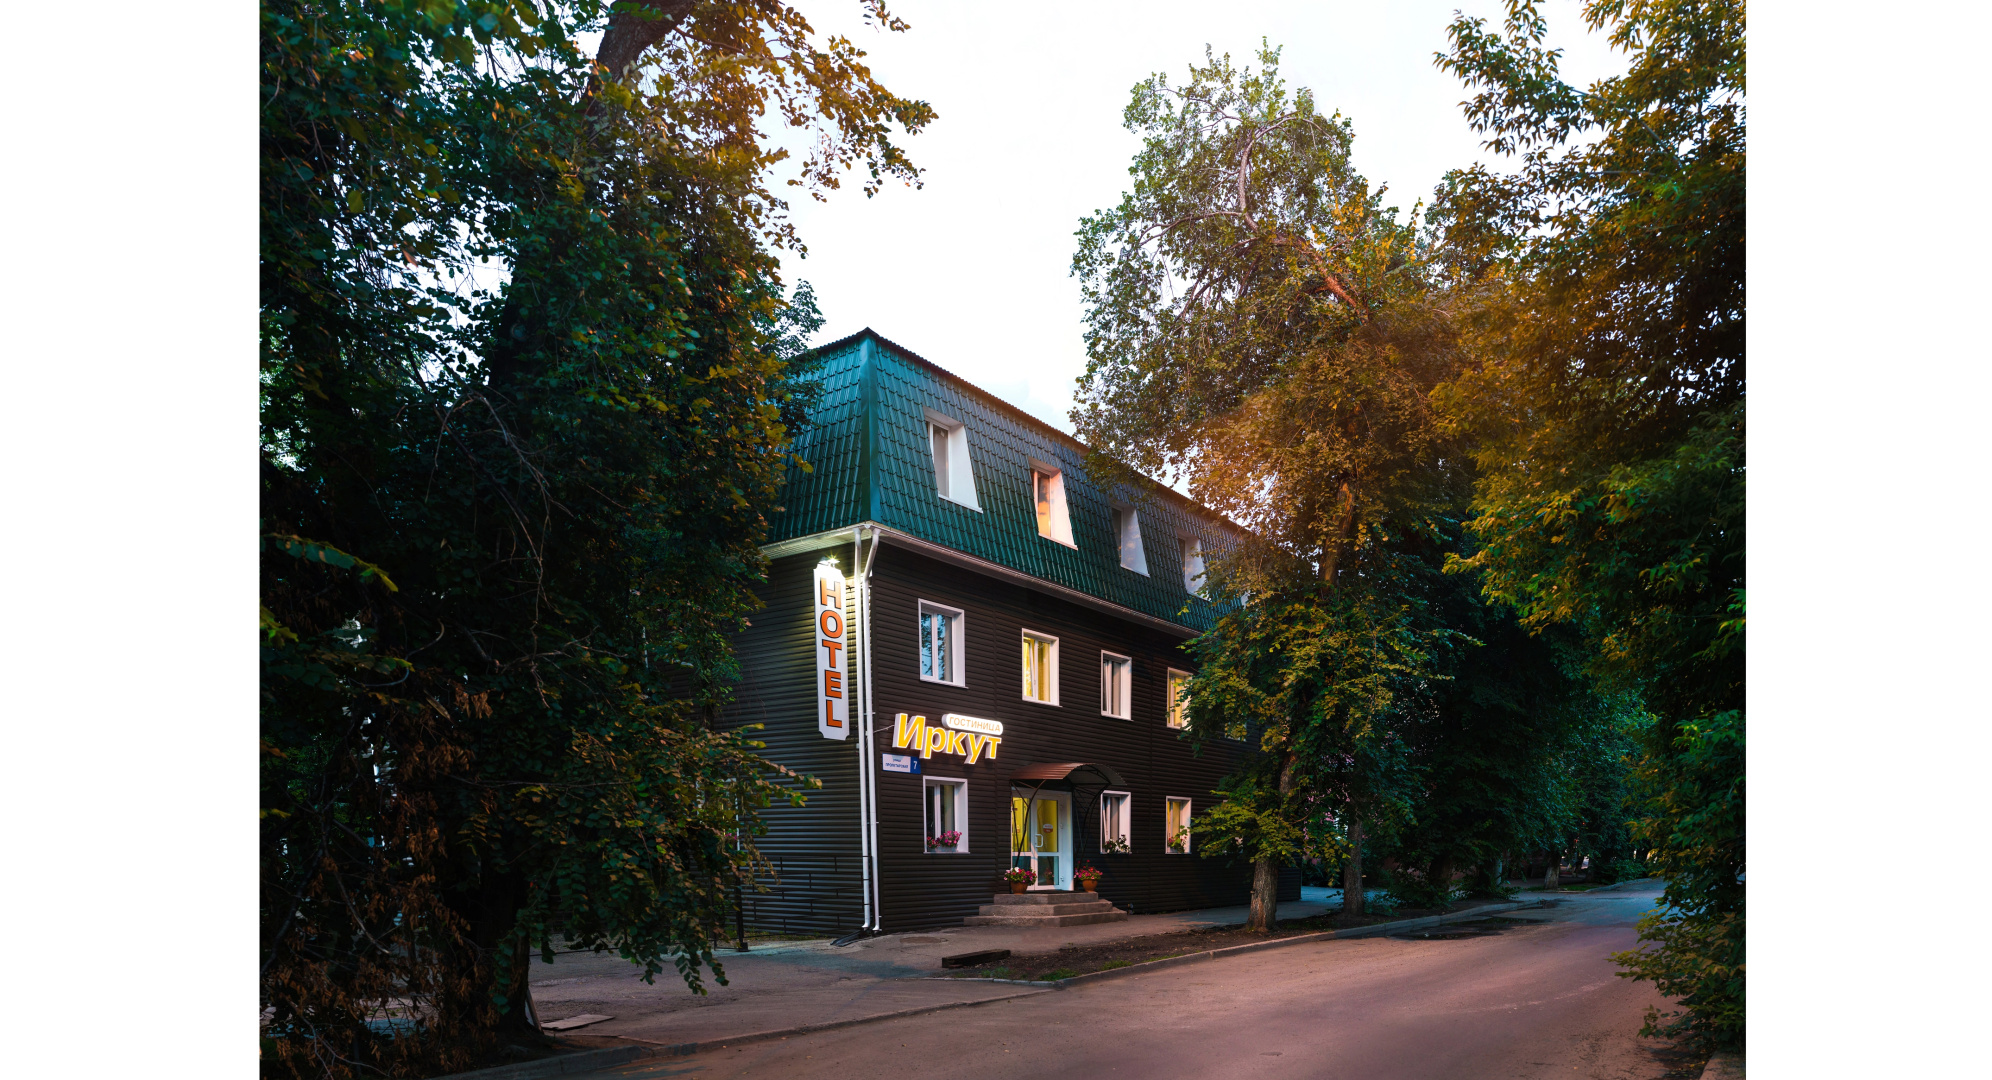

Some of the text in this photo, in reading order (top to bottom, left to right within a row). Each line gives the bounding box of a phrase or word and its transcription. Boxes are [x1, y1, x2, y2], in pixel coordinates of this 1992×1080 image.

[820, 577, 843, 728] HOTEL
[896, 713, 1002, 764] Иркут
[949, 716, 1001, 732] ГОСТИНИЦА
[913, 760, 918, 770] 7
